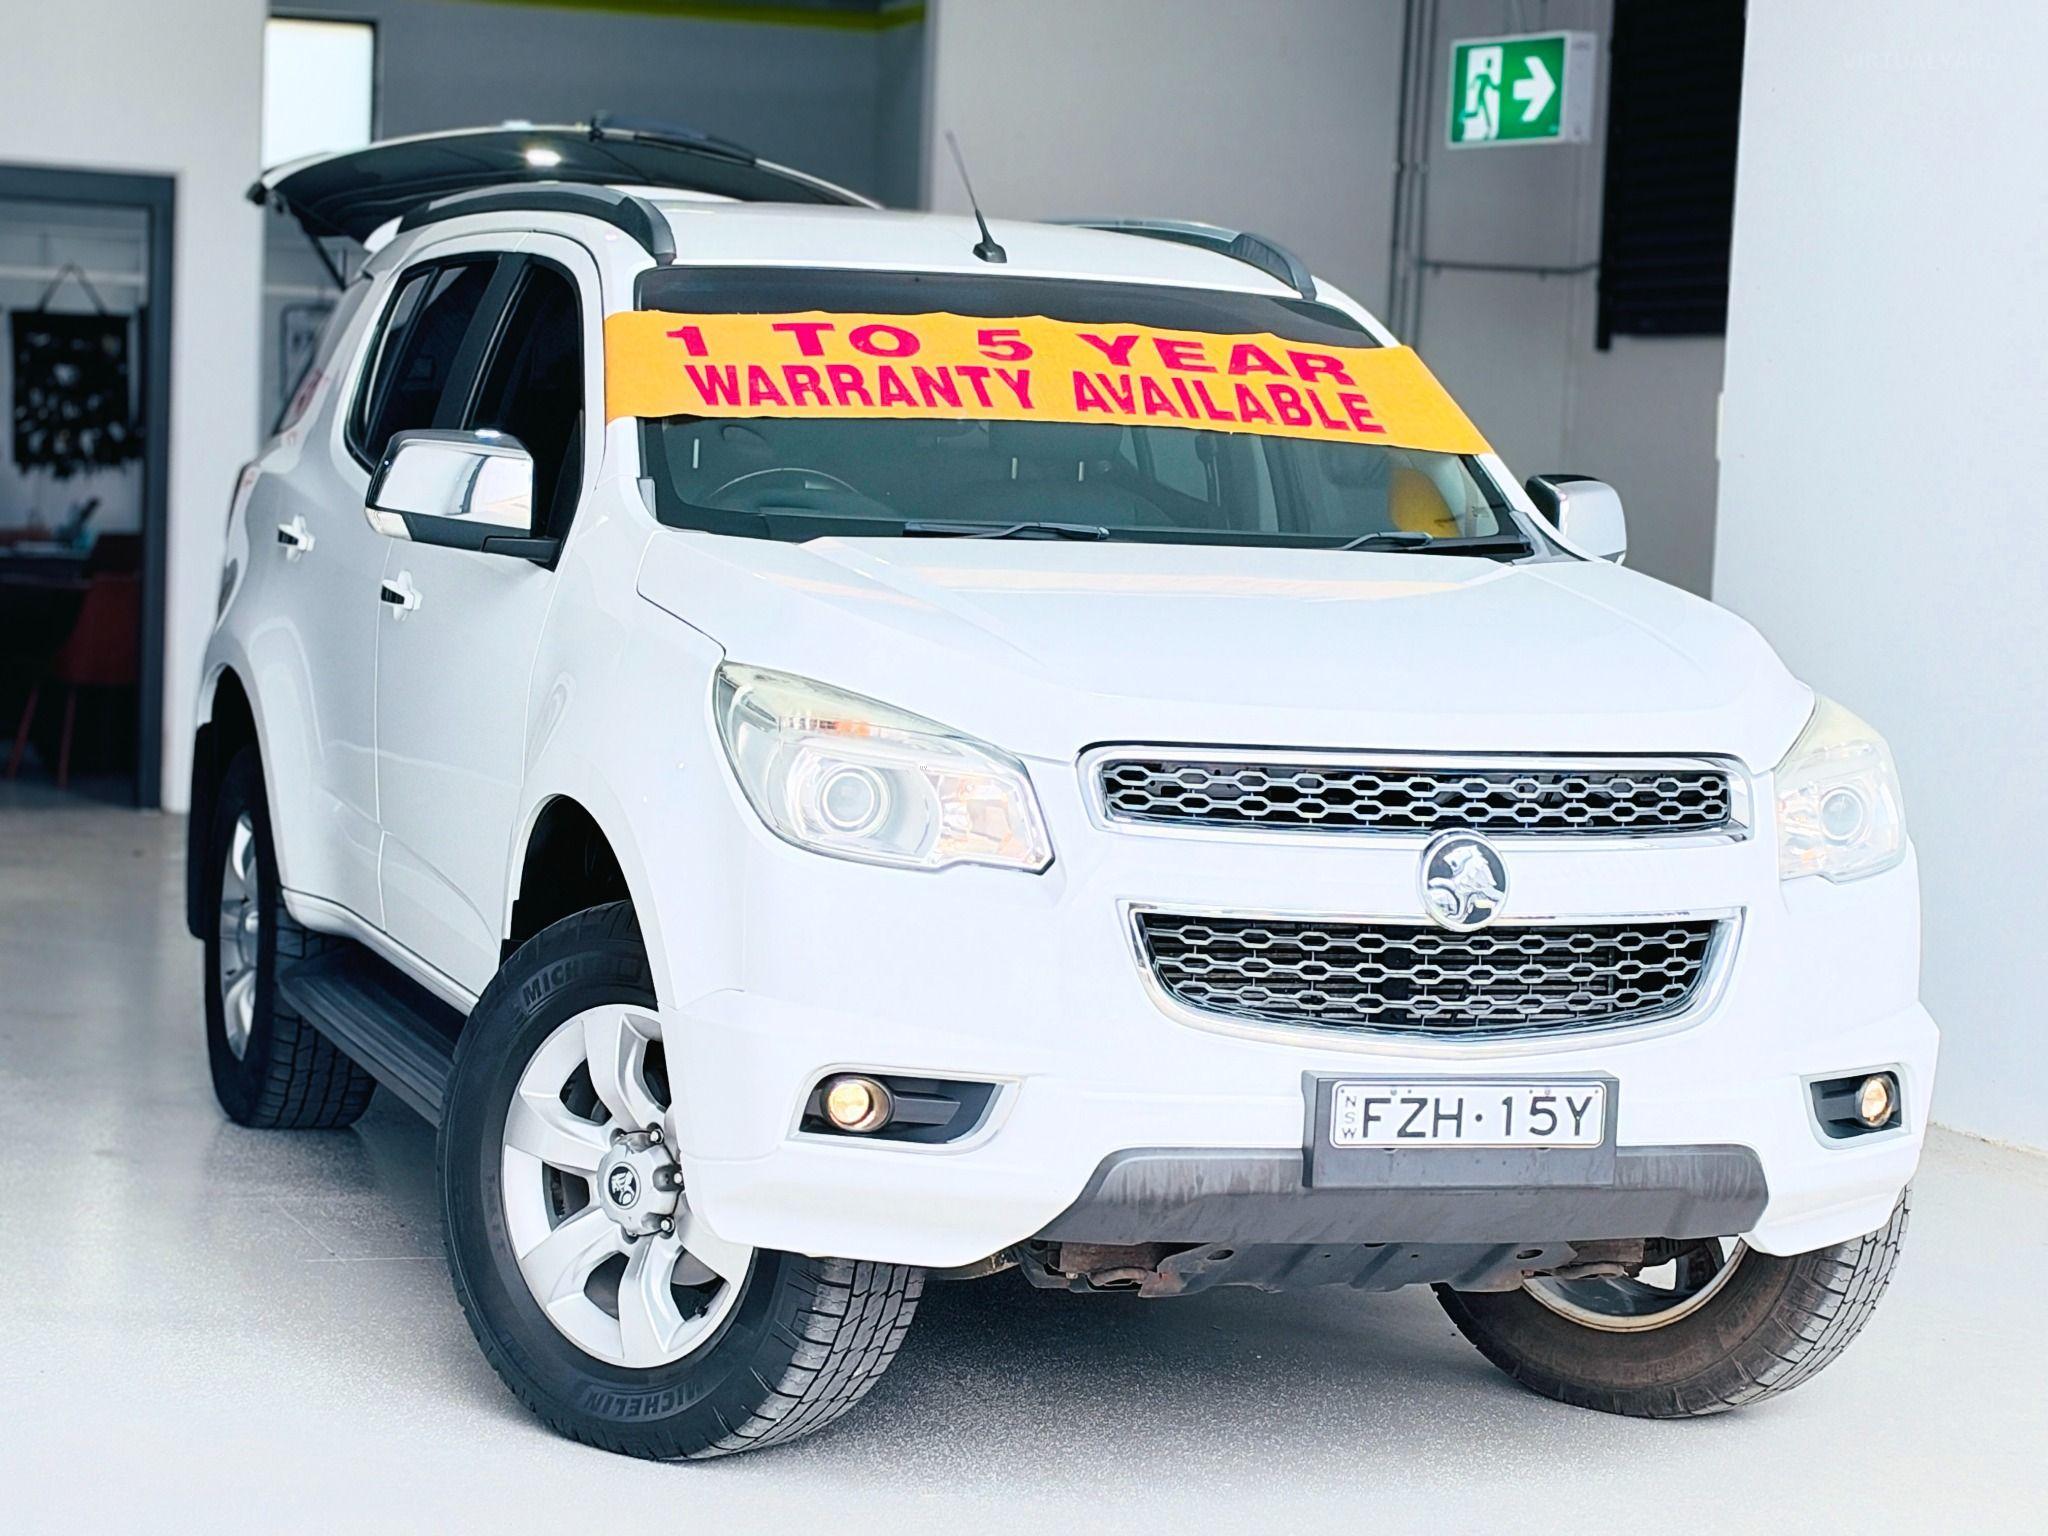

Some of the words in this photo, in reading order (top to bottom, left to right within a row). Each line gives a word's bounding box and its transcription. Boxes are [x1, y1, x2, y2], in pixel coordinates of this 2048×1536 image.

[666, 325, 709, 357] 1
[771, 322, 921, 358] TO
[977, 329, 1033, 362] 5
[1079, 333, 1356, 386] YEAR
[685, 364, 1034, 411] WARRANTY
[1072, 370, 1385, 433] AVAILABLE
